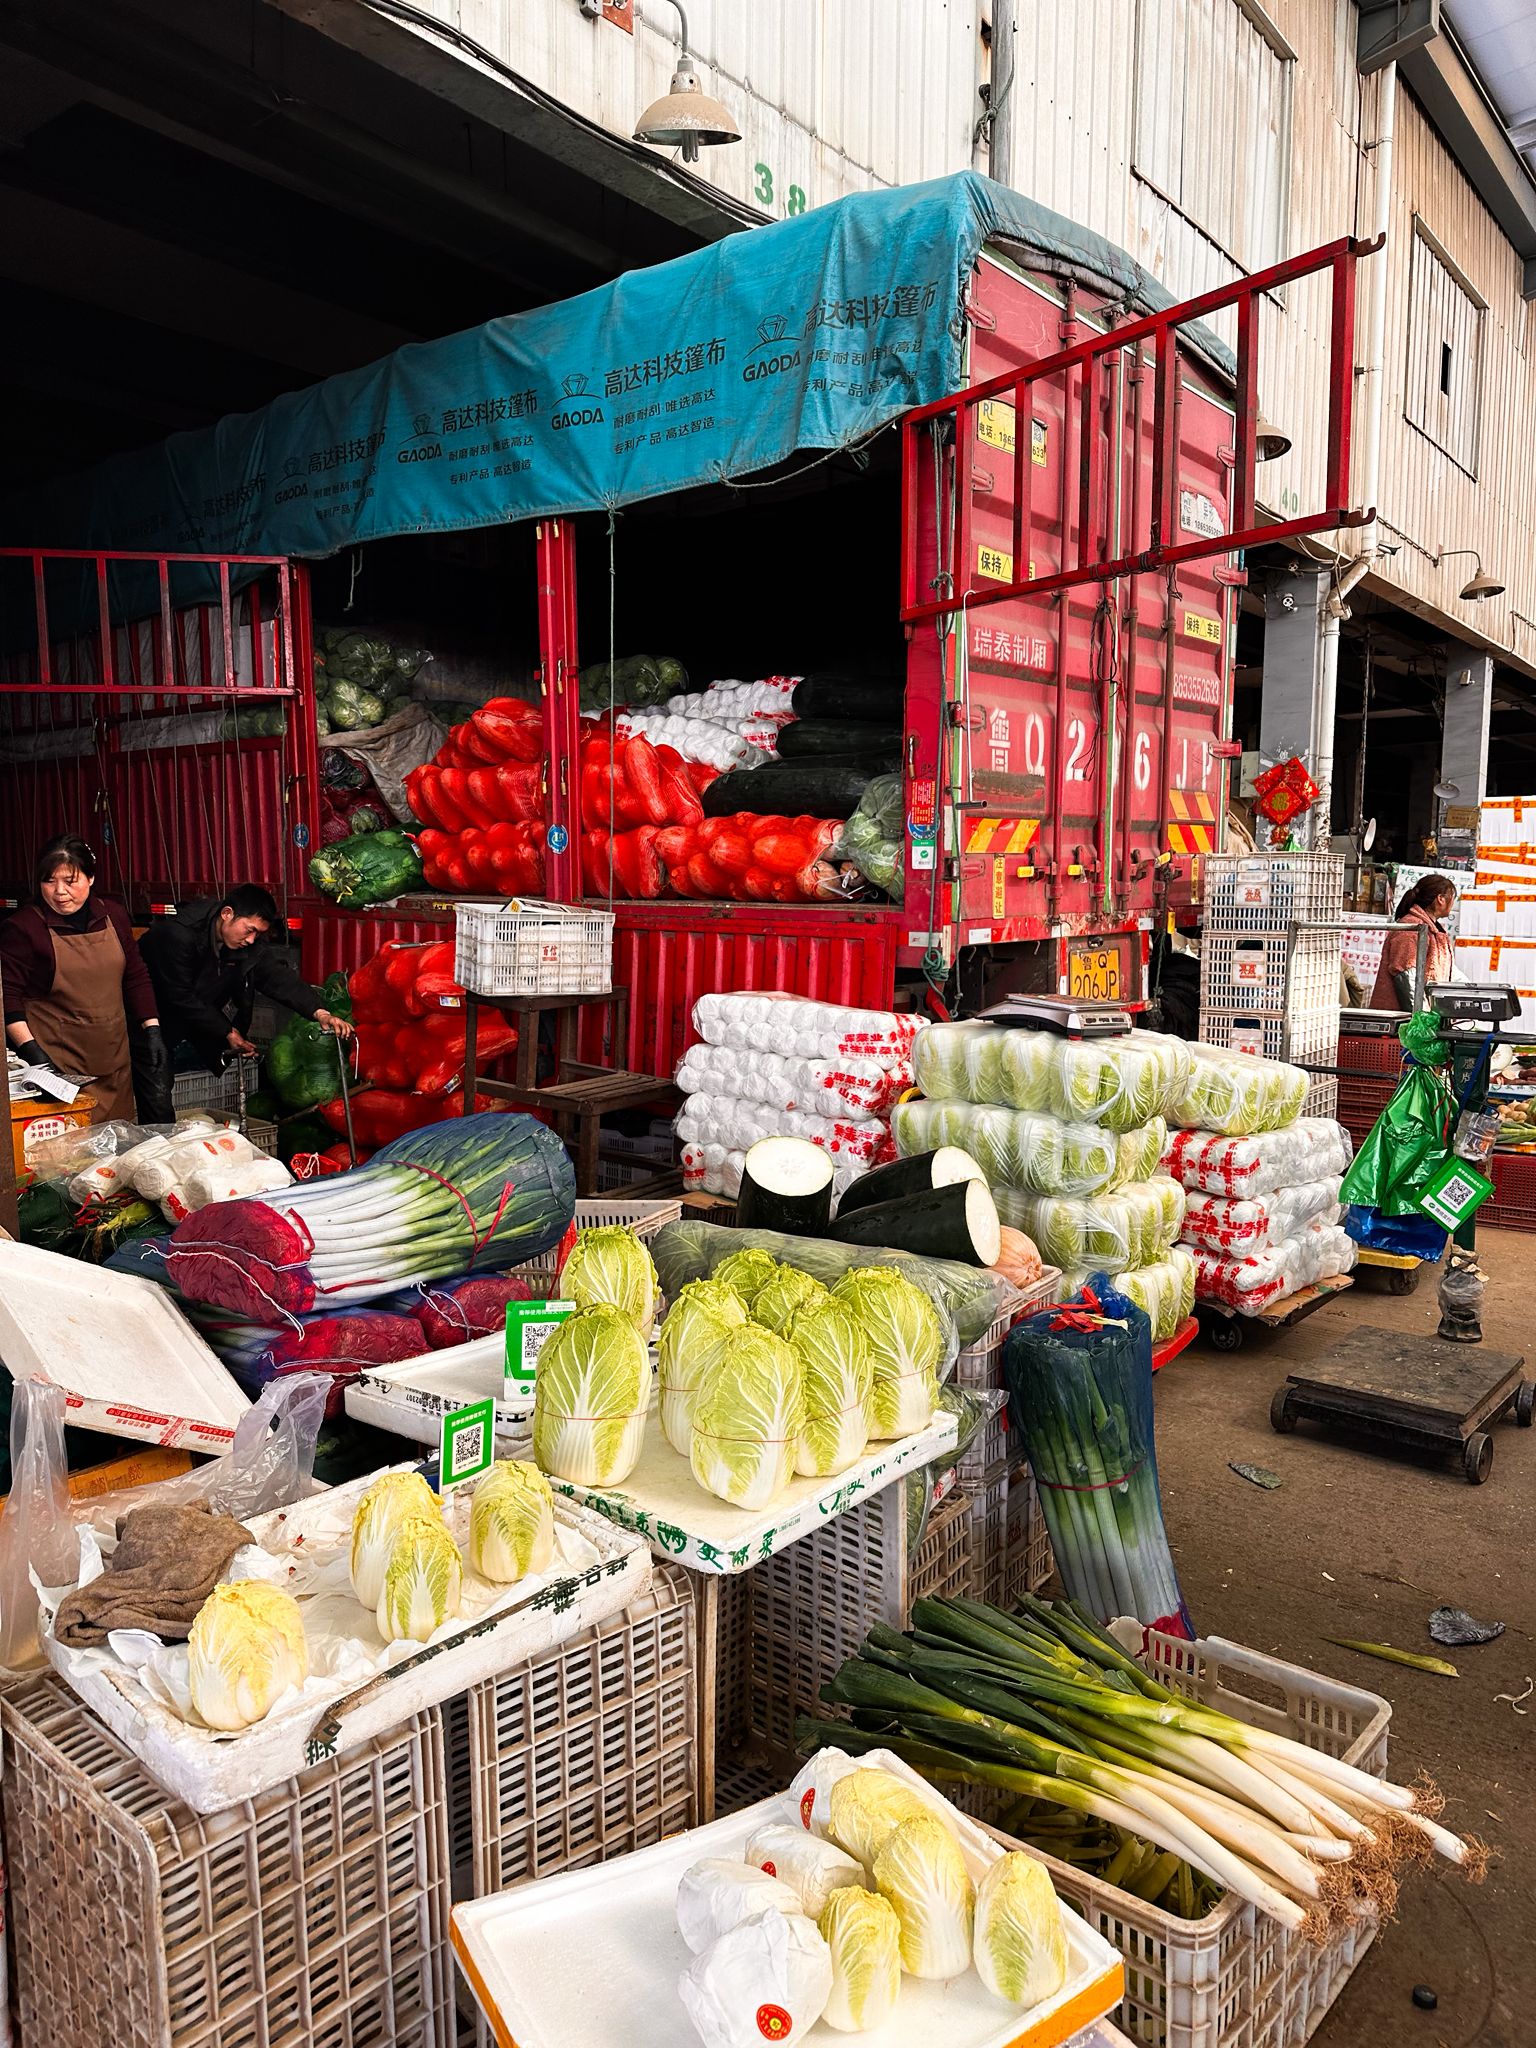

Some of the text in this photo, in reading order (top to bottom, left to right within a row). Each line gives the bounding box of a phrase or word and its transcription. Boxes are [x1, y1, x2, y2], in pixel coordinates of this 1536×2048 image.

[754, 163, 806, 217] 38
[604, 337, 727, 398] 高达科技篷布
[742, 350, 801, 382] GAODA
[442, 388, 538, 435] 高达科技篷布
[551, 408, 604, 431] GAODA
[614, 387, 716, 429] 耐磨耐刮 唯选高达
[614, 416, 716, 455] 专利产品 高达智造
[398, 443, 442, 464] GAODA
[274, 483, 308, 505] GAODA
[981, 550, 1002, 575] 保持
[974, 627, 1047, 669] 瑞泰制厢
[1075, 970, 1118, 999] 206JP
